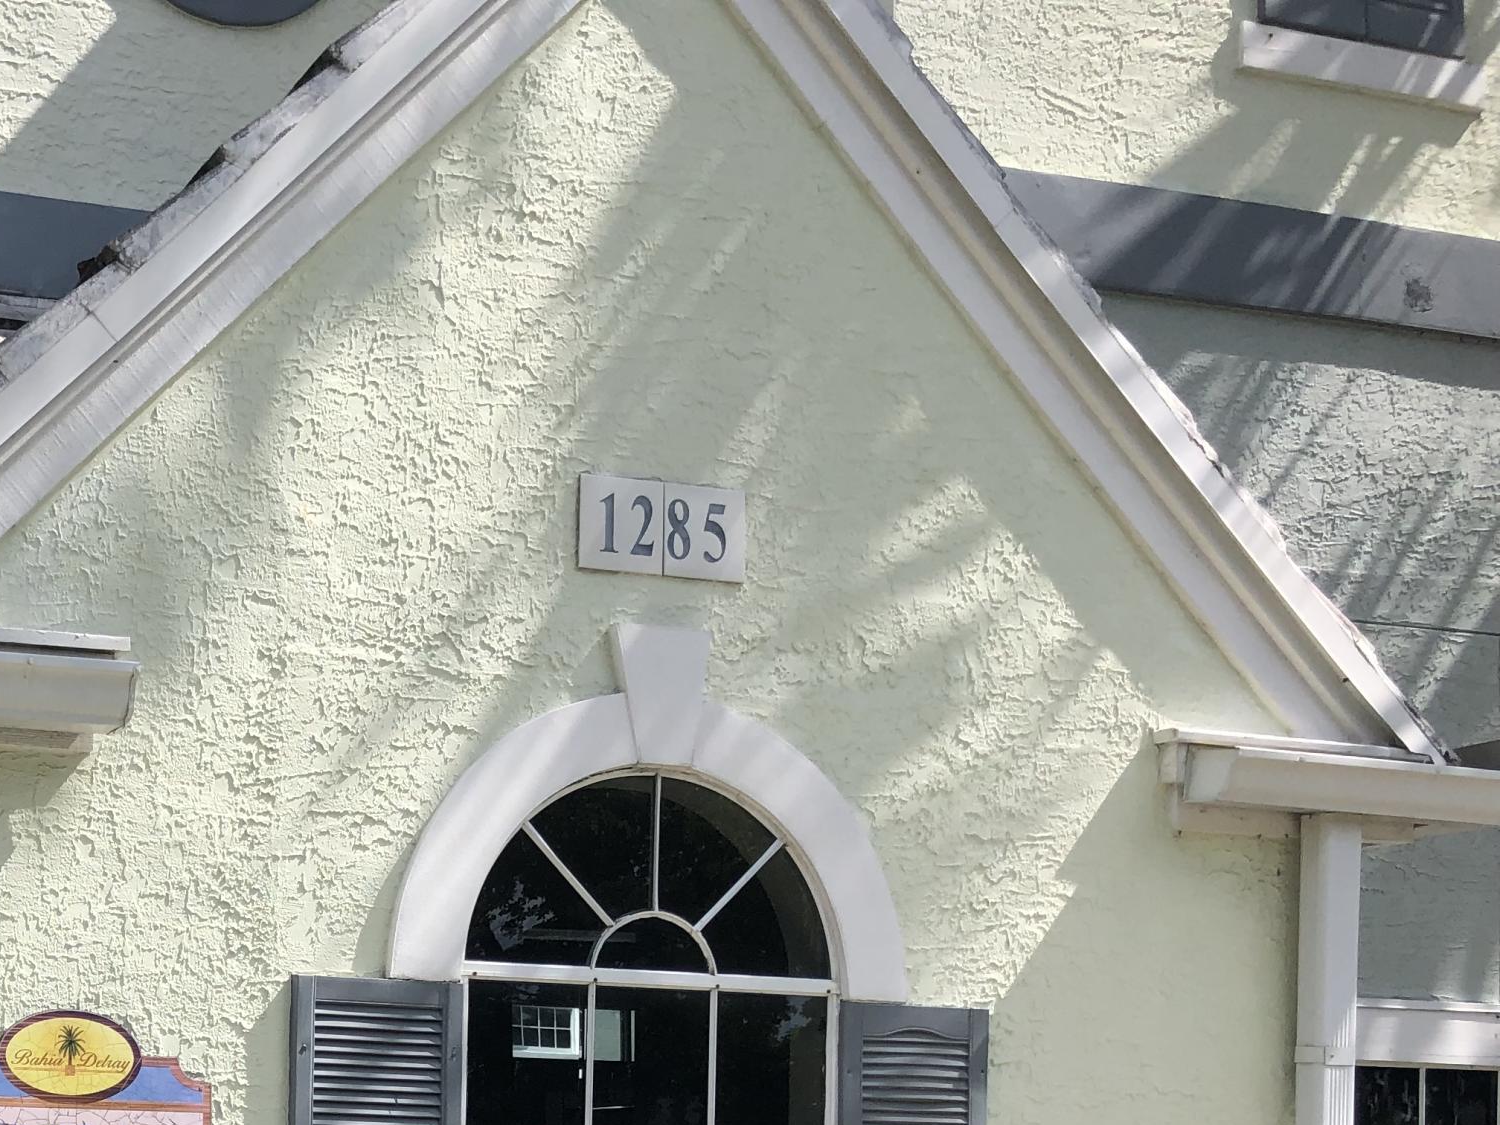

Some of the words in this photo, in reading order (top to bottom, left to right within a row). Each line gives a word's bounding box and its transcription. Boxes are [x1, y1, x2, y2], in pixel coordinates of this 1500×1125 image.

[599, 492, 727, 564] 1285
[11, 1049, 66, 1066] Bahia
[77, 1052, 130, 1071] Delray
